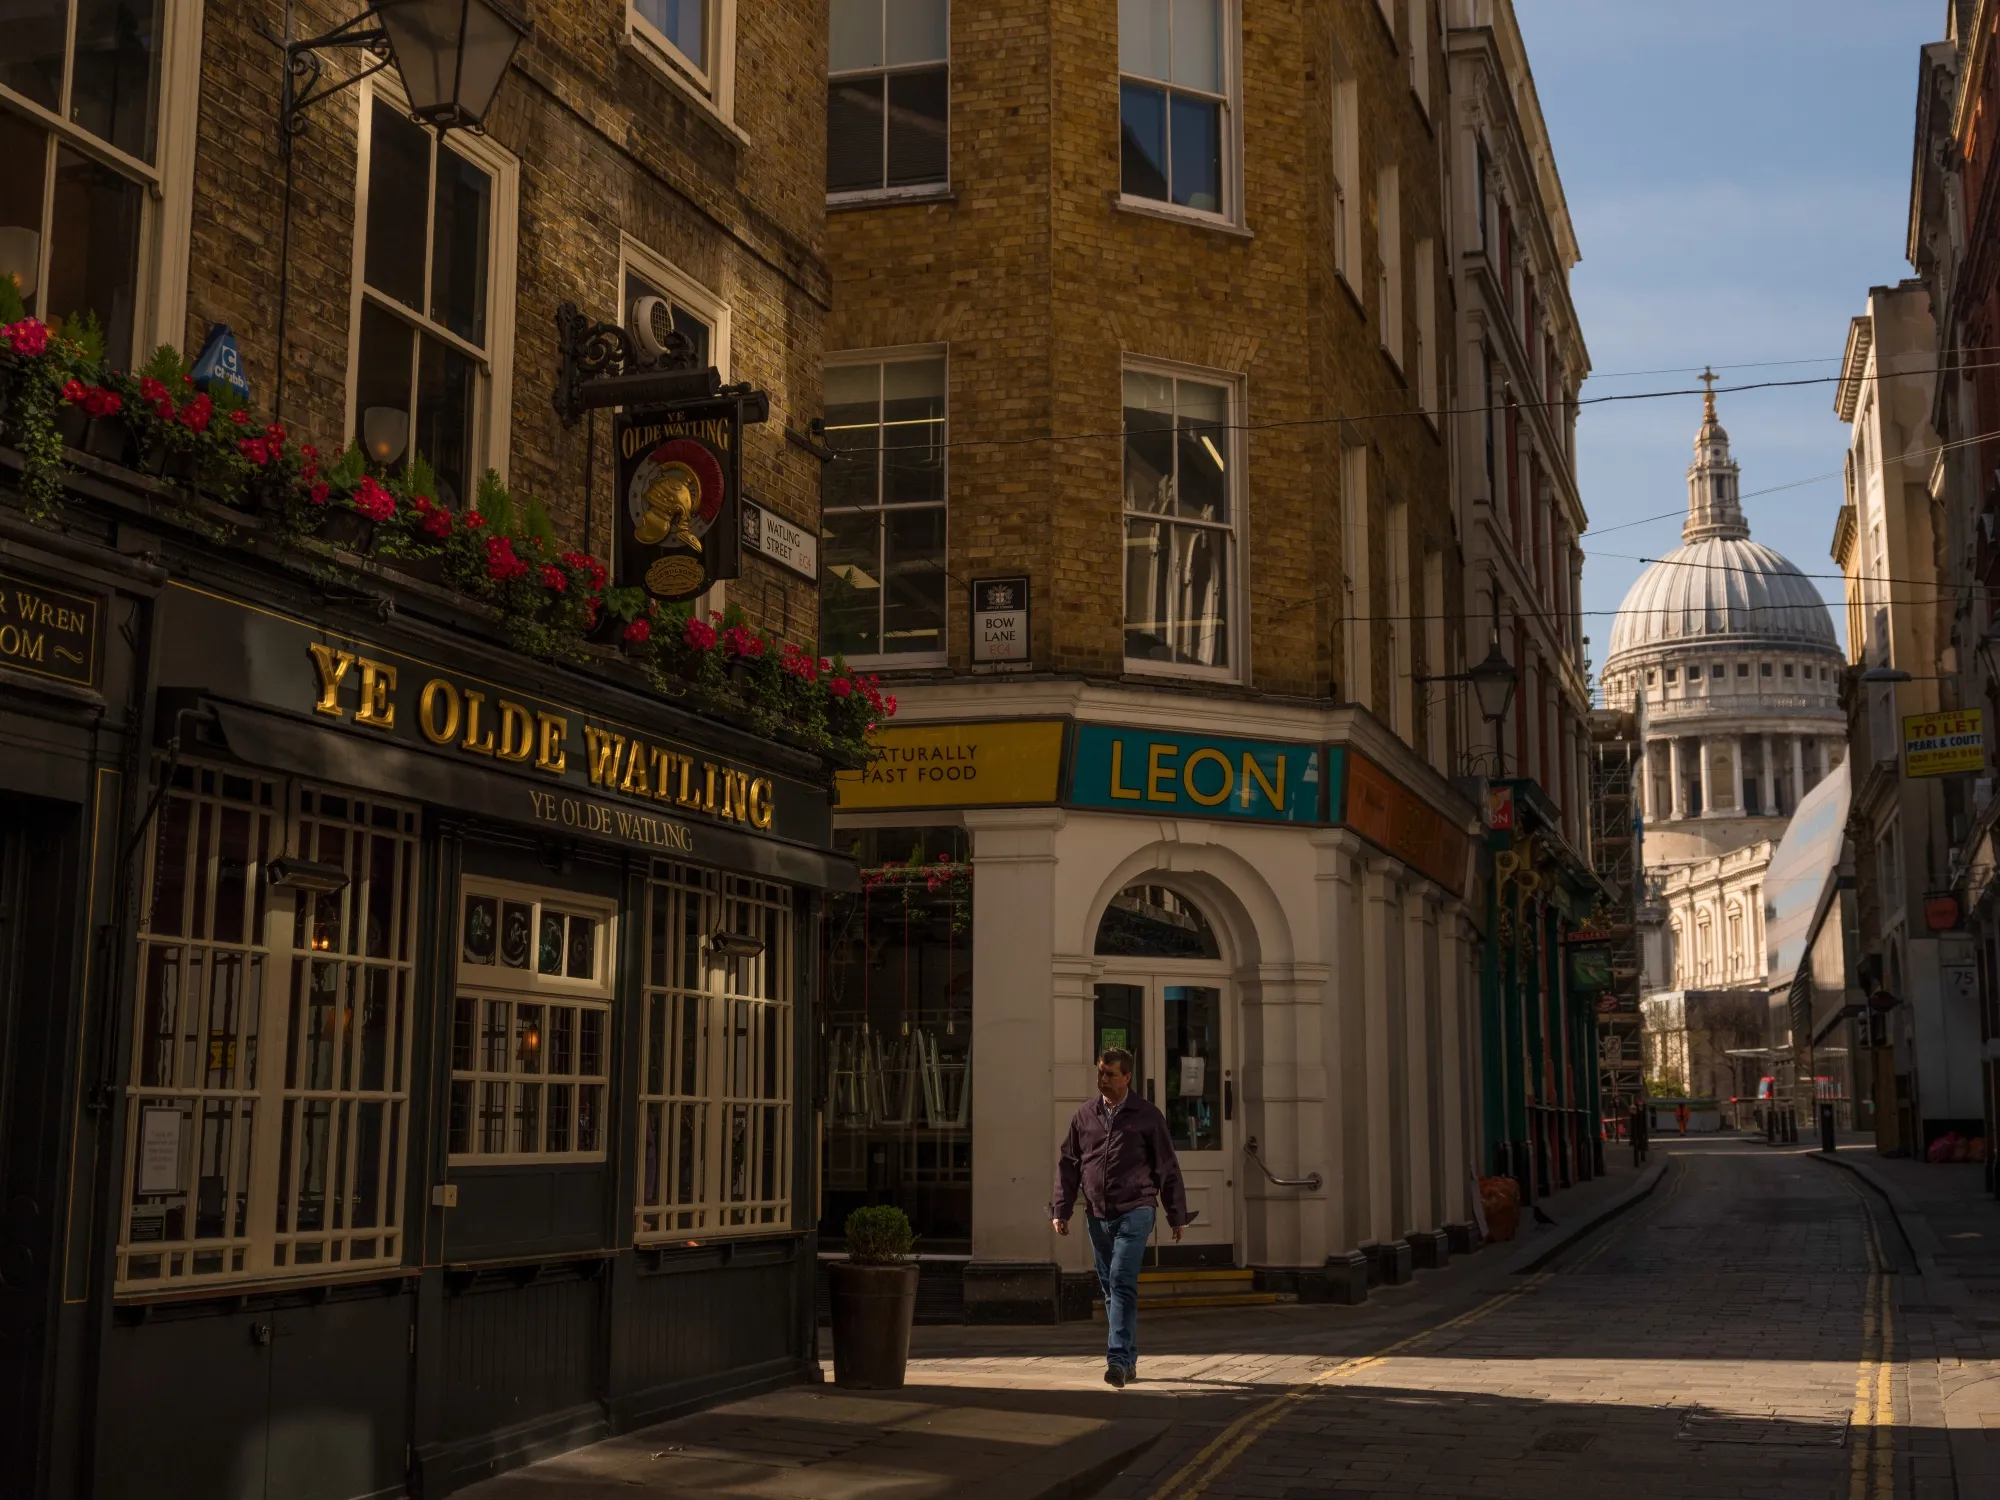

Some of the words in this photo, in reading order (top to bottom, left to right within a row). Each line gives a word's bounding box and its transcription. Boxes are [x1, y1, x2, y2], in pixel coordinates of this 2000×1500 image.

[667, 411, 685, 421] YE
[622, 424, 661, 459] OLDE
[663, 417, 729, 451] WATLING
[767, 518, 800, 547] WATLING
[767, 536, 792, 560] STREET
[799, 553, 811, 570] EC4
[16, 591, 86, 635] WREN
[986, 618, 1014, 629] BOW
[985, 631, 1015, 642] LANE
[990, 644, 1010, 655] EC4
[310, 642, 397, 728] YE
[420, 679, 568, 775] OLDE
[584, 725, 774, 829] WATLING
[1912, 724, 1936, 738] TO
[1944, 719, 1979, 734] LET
[869, 745, 977, 763] ATURALLY
[1908, 740, 1937, 752] PEARL
[862, 768, 908, 783] FAST
[918, 766, 977, 781] FOOD
[1110, 740, 1286, 811] LEON
[529, 790, 557, 821] YE
[561, 799, 612, 834] OLDE
[615, 811, 693, 851] WATLING
[1954, 971, 1974, 984] 75
